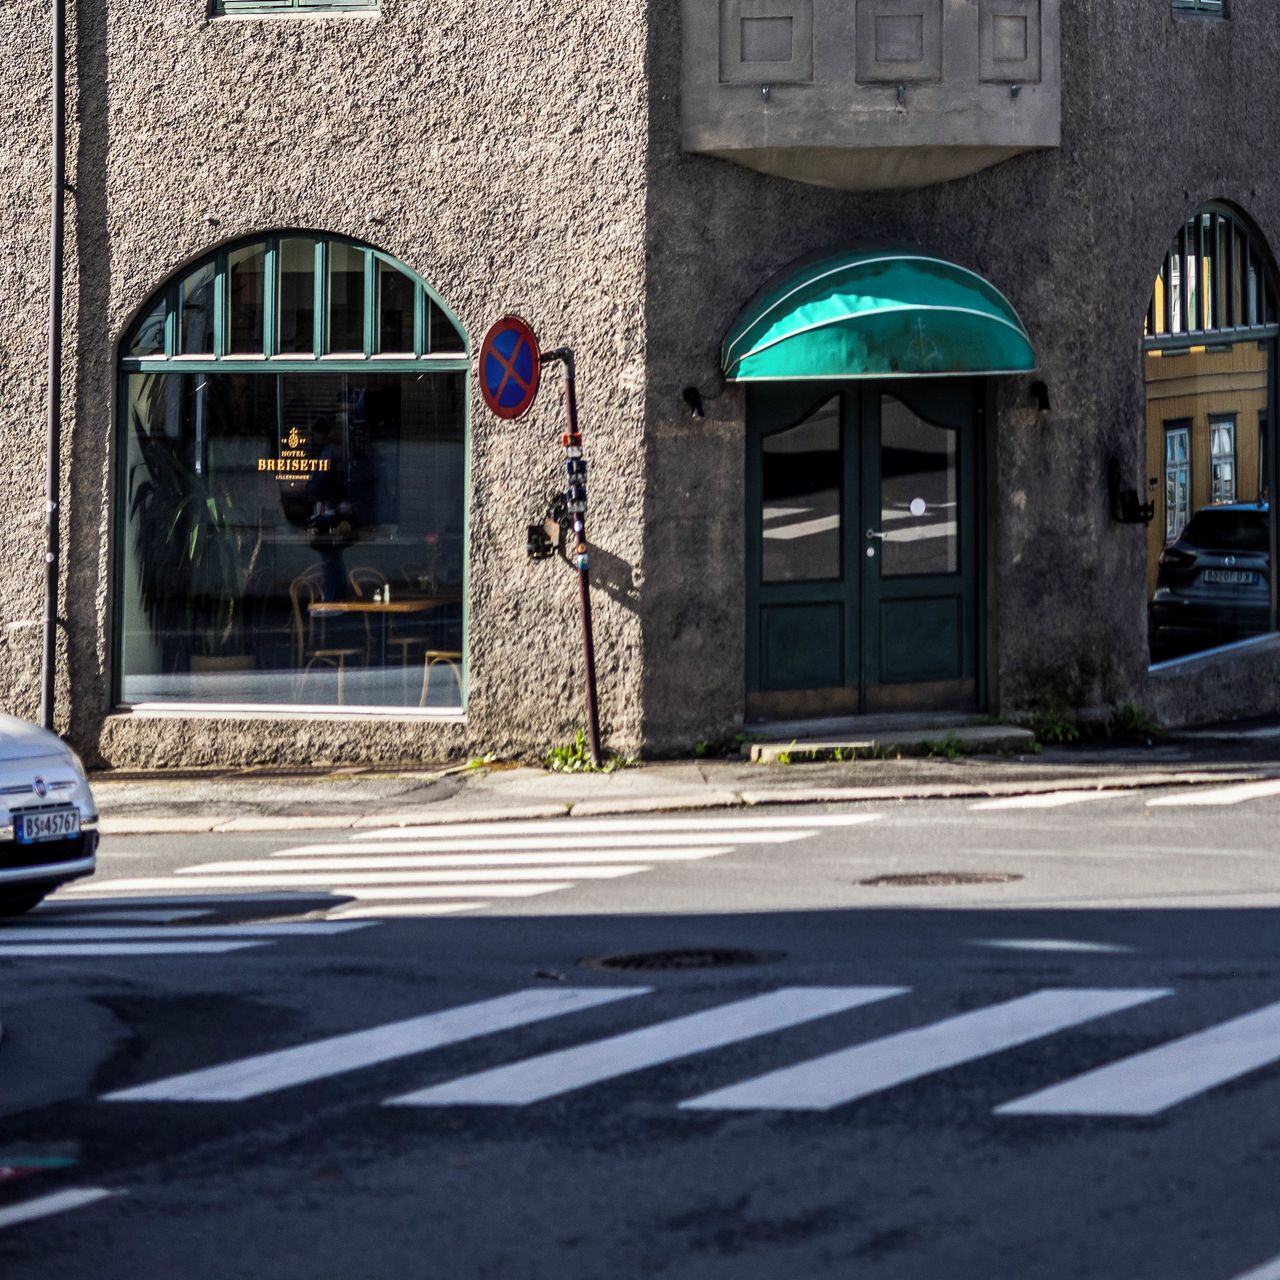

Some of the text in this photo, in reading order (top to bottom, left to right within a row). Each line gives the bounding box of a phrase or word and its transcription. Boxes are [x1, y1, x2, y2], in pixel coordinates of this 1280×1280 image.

[281, 450, 306, 458] HOTEL
[257, 458, 329, 472] BREISETH
[26, 812, 77, 838] BS 45767
